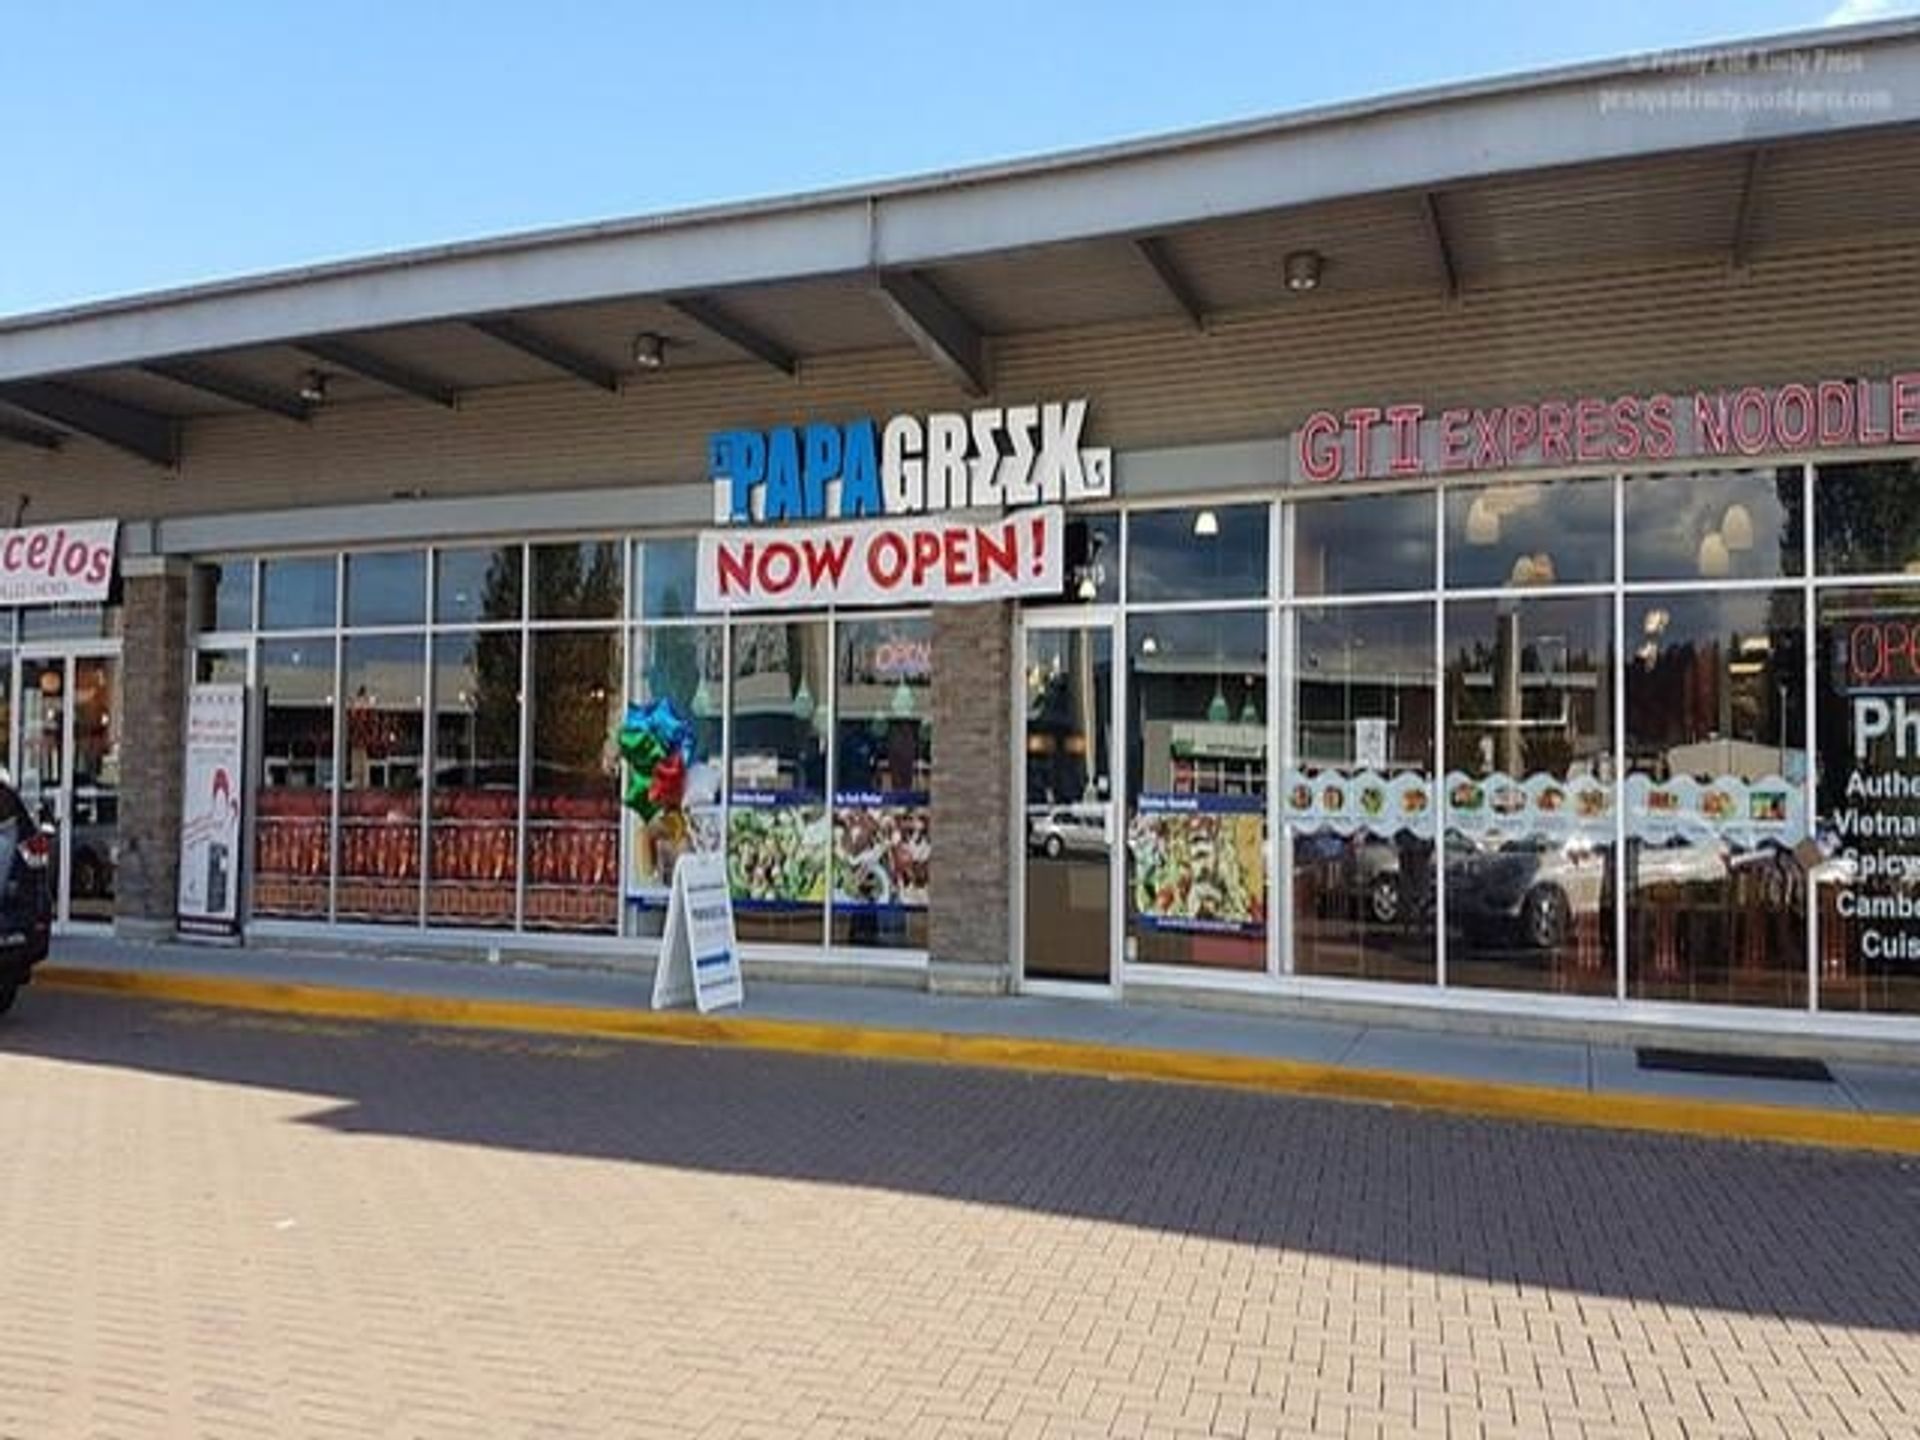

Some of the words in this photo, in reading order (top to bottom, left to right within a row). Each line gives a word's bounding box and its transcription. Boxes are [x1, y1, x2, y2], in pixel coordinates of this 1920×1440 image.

[1439, 394, 1679, 470] EXPRESS
[1694, 371, 1920, 455] NOODLE
[3, 529, 110, 584] celos
[717, 535, 853, 596] NOW
[1833, 808, 1920, 837] Vietna
